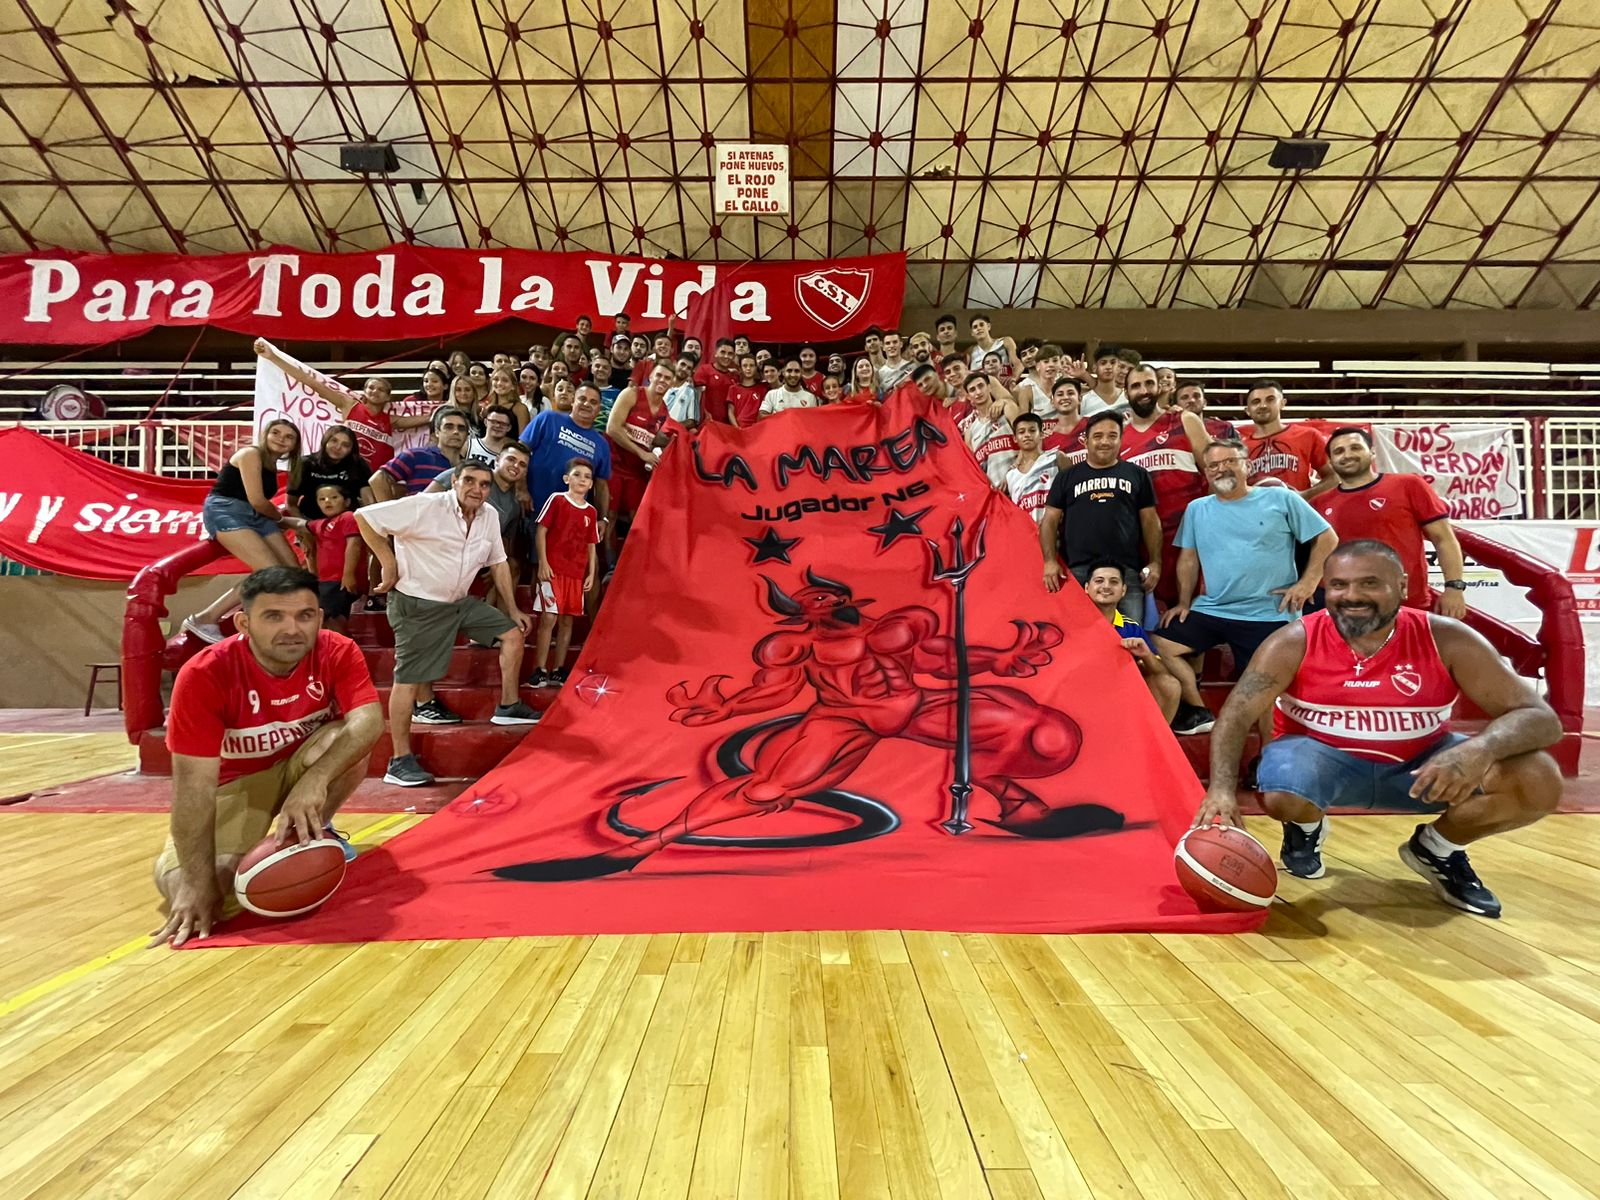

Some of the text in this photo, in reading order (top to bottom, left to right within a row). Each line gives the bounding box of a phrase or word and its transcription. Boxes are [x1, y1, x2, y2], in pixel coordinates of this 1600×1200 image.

[720, 161, 784, 171] PONE HUEVOS
[727, 151, 774, 160] SI ATENAS
[727, 174, 775, 186] EL ROJO
[737, 188, 769, 199] PONE
[724, 200, 779, 212] EL GALLO
[23, 253, 772, 322] Para Toda la Vida
[281, 392, 331, 421] VOS
[560, 426, 596, 448] UNDER
[557, 440, 595, 459] ARMOUR
[691, 415, 948, 491] LA MAREA
[1074, 477, 1132, 498] NARROW CO
[740, 493, 875, 522] Jugador
[1449, 496, 1501, 520] IABLO
[27, 495, 65, 544] y
[1343, 680, 1381, 688] RUNUP
[248, 689, 260, 714] 9
